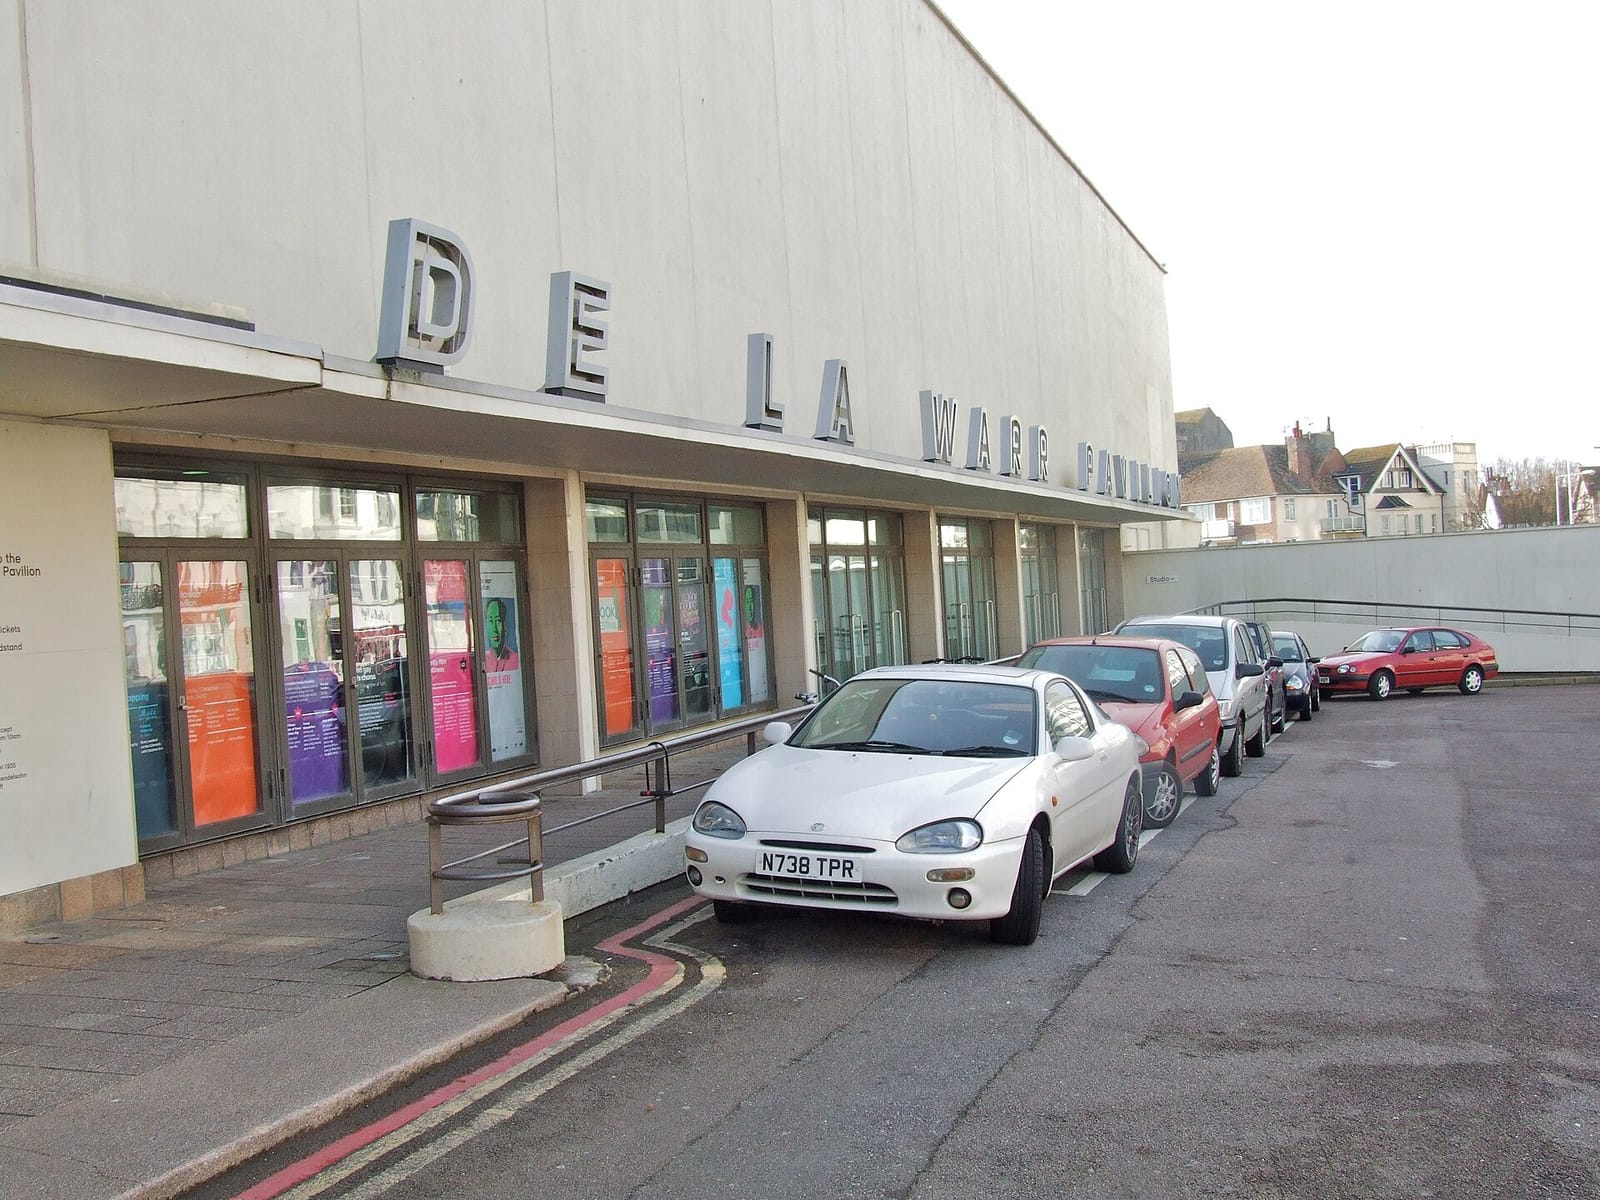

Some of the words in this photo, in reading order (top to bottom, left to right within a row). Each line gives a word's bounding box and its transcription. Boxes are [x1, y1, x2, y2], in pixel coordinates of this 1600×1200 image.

[376, 217, 611, 397] DE
[745, 332, 855, 446] LA
[919, 389, 1048, 483] WARR
[5, 553, 21, 563] the
[3, 566, 41, 576] Pavilion
[762, 852, 810, 875] N738
[816, 857, 854, 878] TPR
